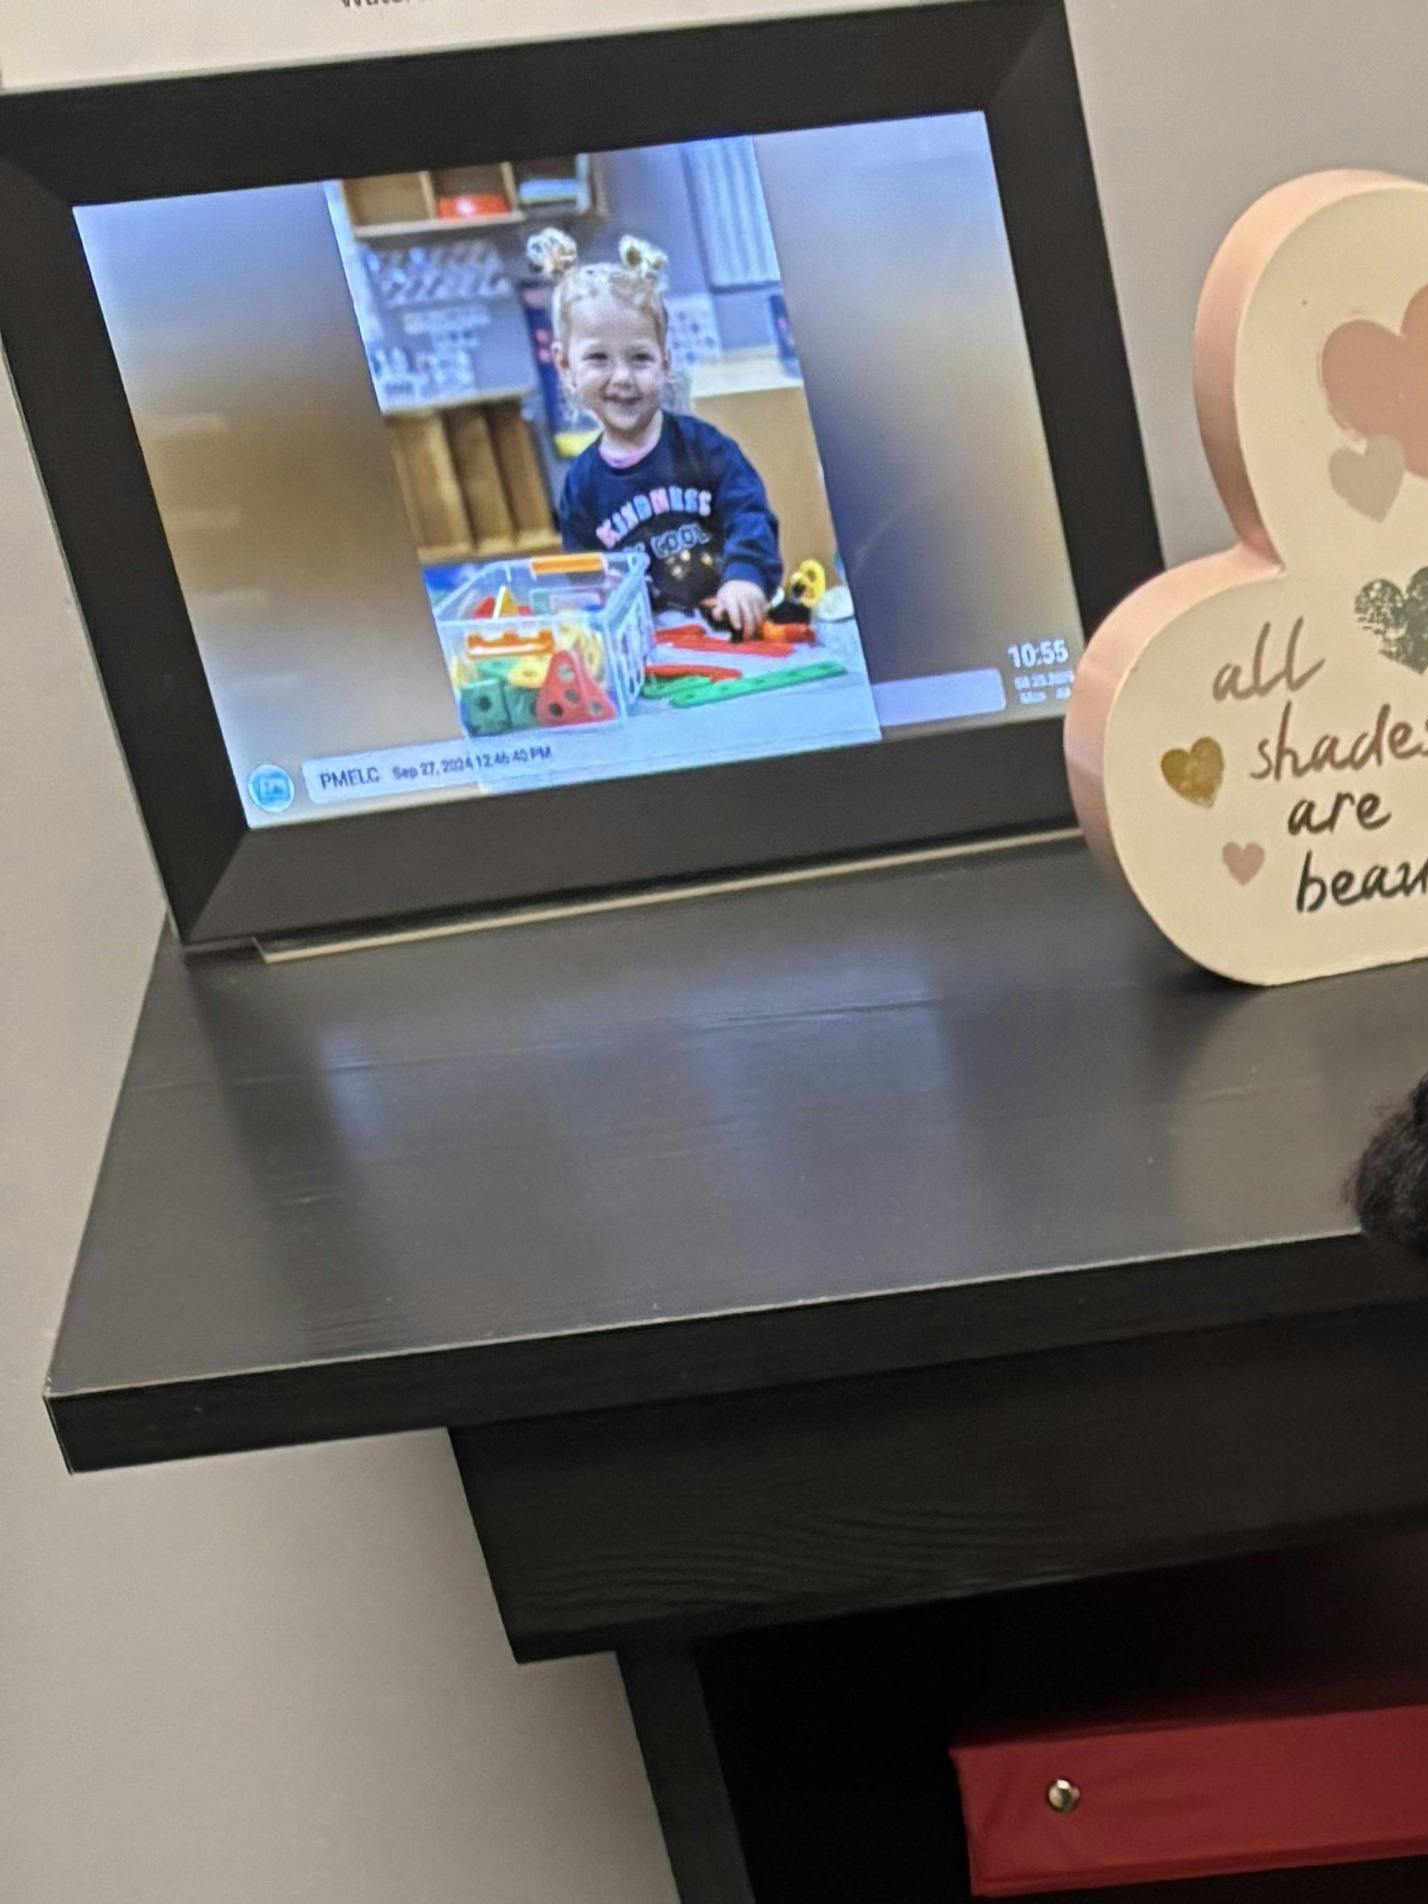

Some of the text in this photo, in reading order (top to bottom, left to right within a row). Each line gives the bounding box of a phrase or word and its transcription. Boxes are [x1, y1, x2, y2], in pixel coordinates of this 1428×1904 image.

[1007, 639, 1069, 669] 10:55
[1212, 616, 1326, 702] all
[319, 766, 381, 791] PMELC
[1287, 790, 1392, 836] are
